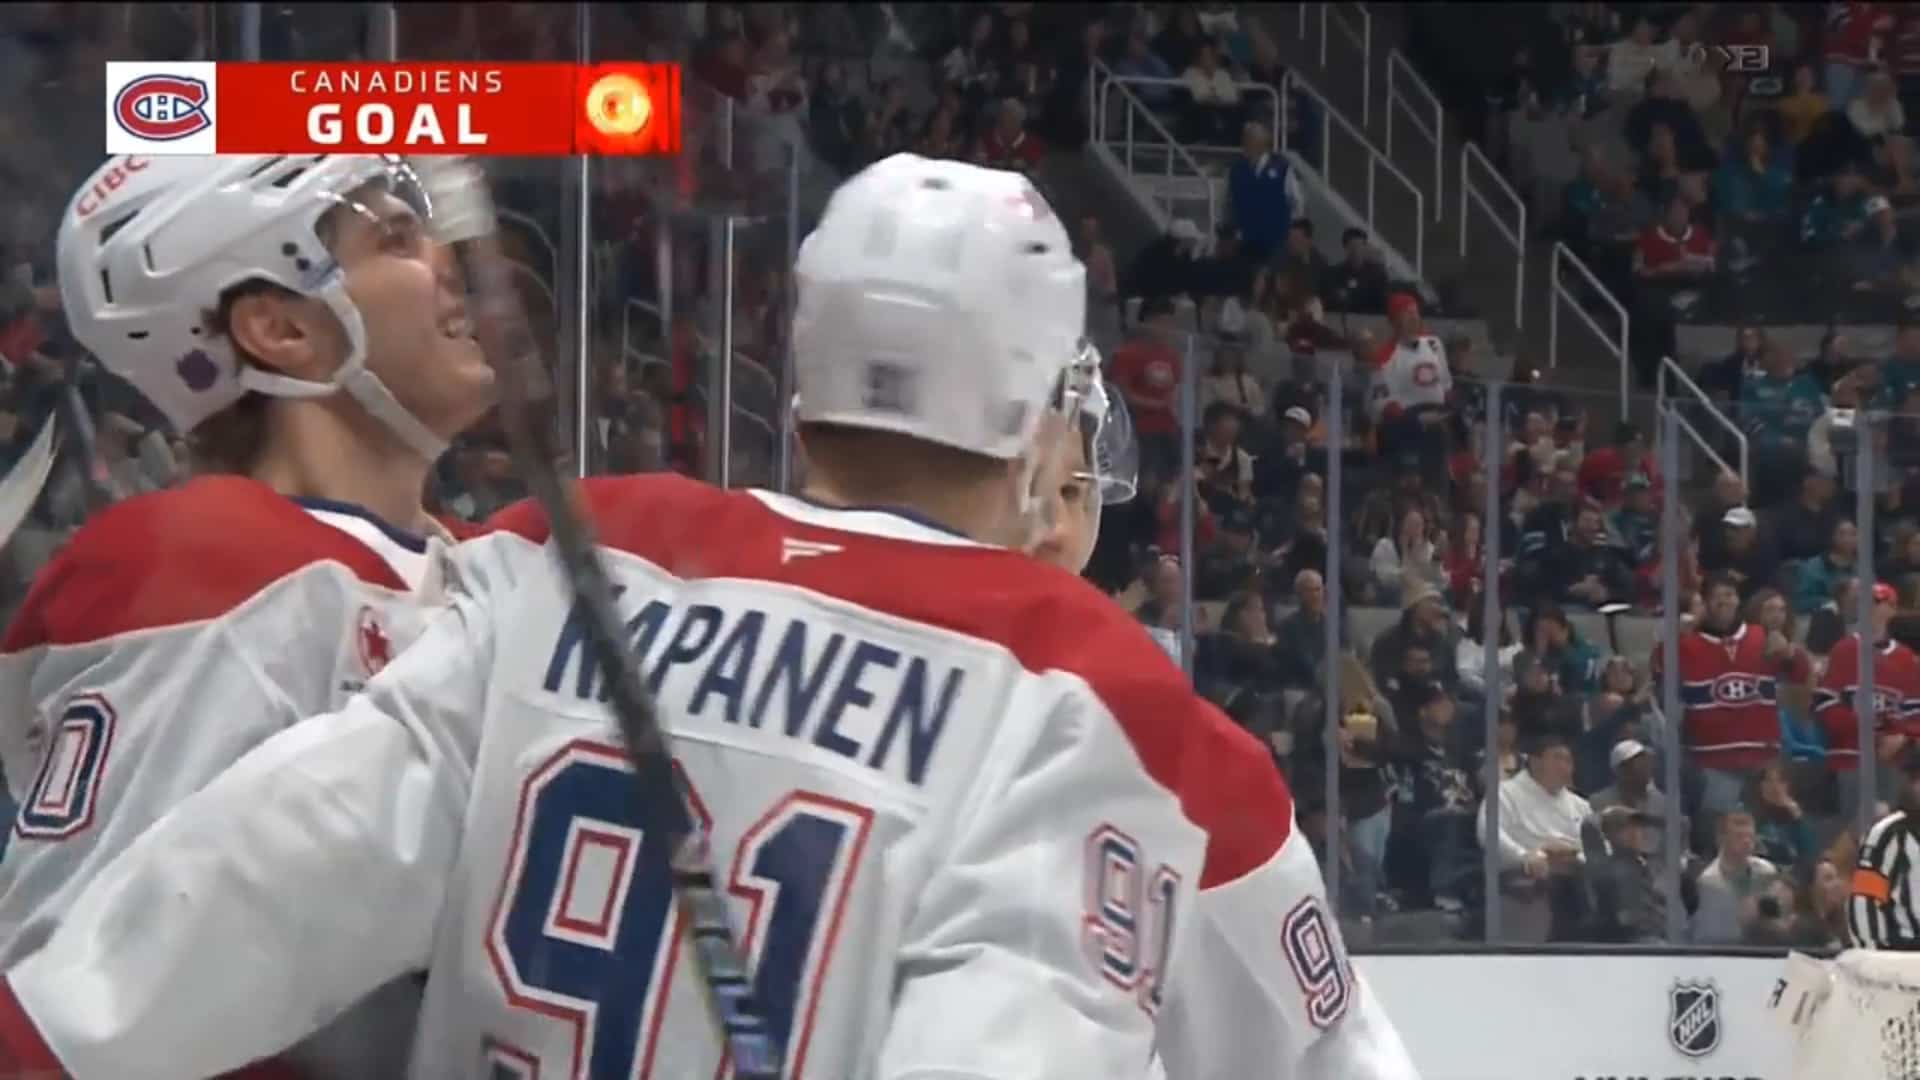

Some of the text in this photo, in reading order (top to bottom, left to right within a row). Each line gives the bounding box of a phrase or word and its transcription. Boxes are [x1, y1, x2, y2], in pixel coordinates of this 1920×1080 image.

[76, 155, 149, 217] CIBC
[16, 692, 117, 841] 0
[484, 737, 875, 1080] 91
[1080, 821, 1182, 1024] 91
[1281, 894, 1356, 1030] 9
